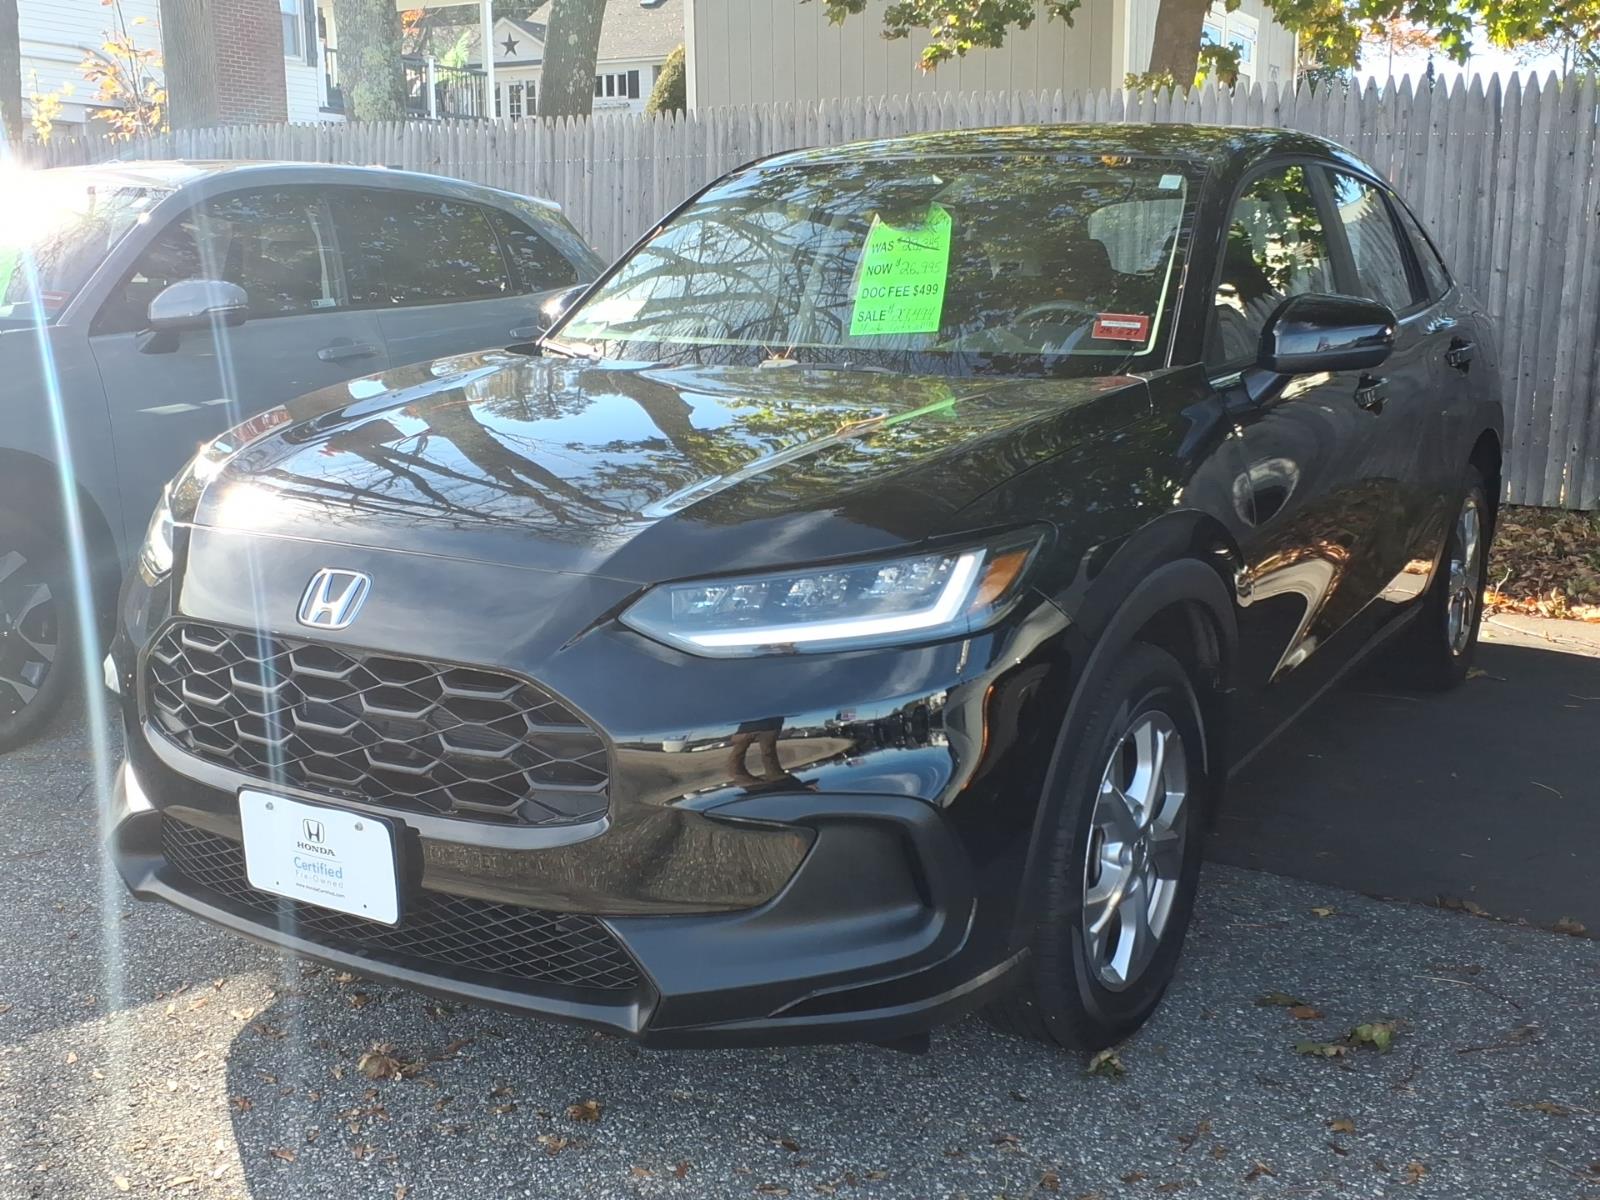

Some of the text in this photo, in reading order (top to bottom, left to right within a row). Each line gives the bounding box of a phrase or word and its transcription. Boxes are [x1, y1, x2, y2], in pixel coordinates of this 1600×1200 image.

[871, 240, 895, 254] WAS
[866, 263, 893, 276] NOW
[861, 283, 939, 299] DOC FEE $499
[857, 310, 886, 322] SALE
[296, 841, 336, 857] HONDA
[293, 856, 343, 879] Certified
